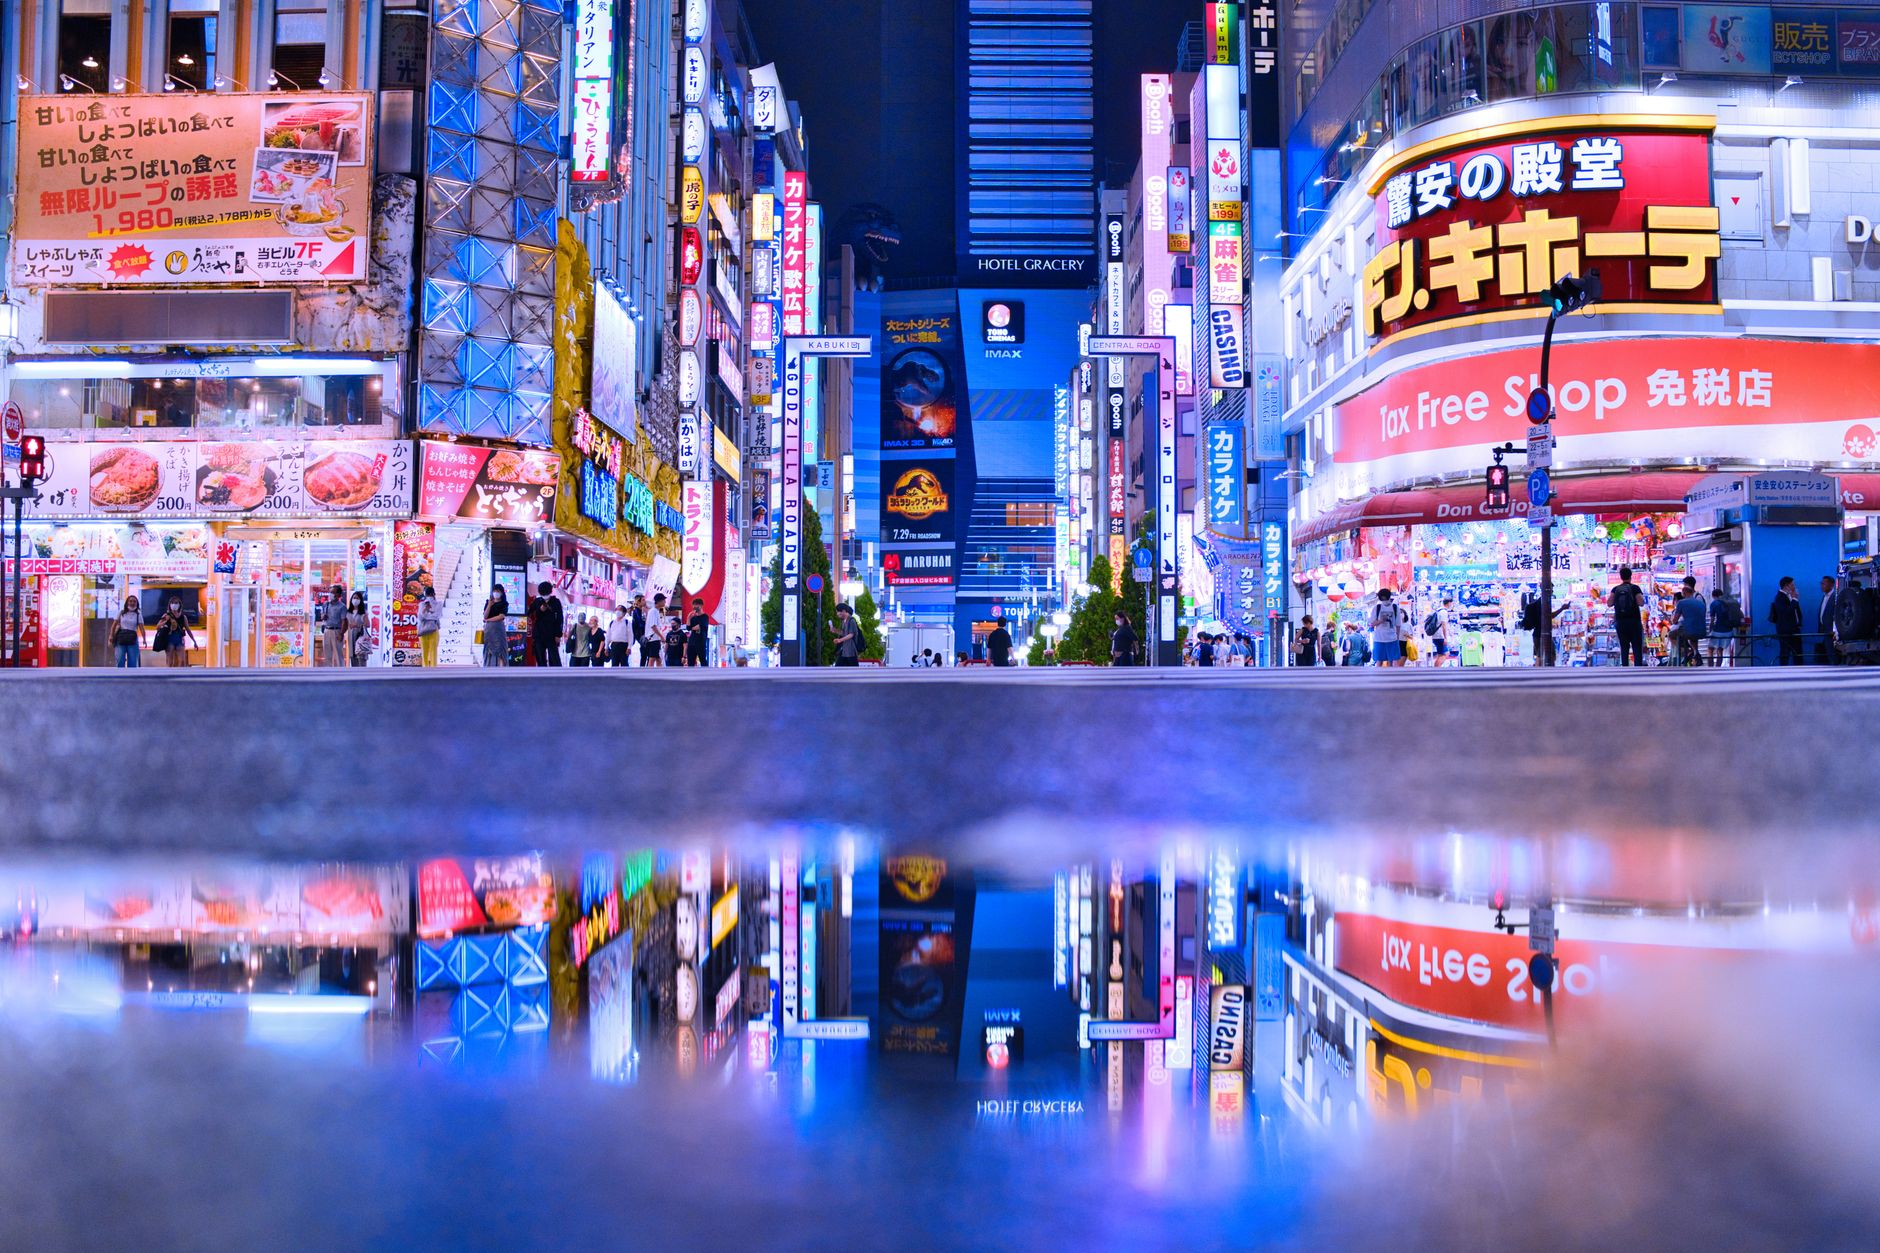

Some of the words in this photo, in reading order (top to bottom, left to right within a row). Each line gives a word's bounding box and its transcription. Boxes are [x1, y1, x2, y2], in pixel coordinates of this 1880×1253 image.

[1774, 22, 1829, 51] 販売
[35, 102, 132, 126] 甘いの食べて
[758, 90, 770, 122] ダーツ
[1145, 82, 1166, 135] Booth
[581, 97, 600, 169] ひょうたん
[37, 143, 134, 168] 甘いの食べて
[582, 171, 598, 180] 7F
[1385, 136, 1626, 230] 驚安の殿堂
[40, 172, 239, 217] 無限ループの誘惑
[685, 183, 701, 211] 虎の子
[1146, 176, 1167, 231] Booth
[1109, 221, 1123, 257] Booth
[1215, 223, 1236, 235] 4F
[26, 247, 103, 261] しゃぶしゃぶ
[113, 255, 147, 269] 食べ放題
[257, 242, 323, 261] 当ビル7F
[783, 178, 804, 335] カラオケ歌広場
[1214, 239, 1238, 283] 麻雀
[25, 264, 74, 277] スイーツ
[978, 259, 1024, 270] HOTEL
[1024, 259, 1085, 271] GRACERY
[886, 318, 950, 331] 大ヒットシリーズ
[985, 350, 1022, 358] IMAX
[1212, 309, 1242, 383] CASINO
[1645, 368, 1773, 408] 免税店
[1056, 388, 1067, 420] 747
[1109, 393, 1123, 430] Booth
[1380, 403, 1411, 442] Tax
[1417, 387, 1489, 430] Free
[1503, 373, 1627, 420] Shop
[786, 373, 798, 485] GODZILLA
[911, 439, 925, 447] 3D
[392, 443, 408, 491] かつ丼
[428, 451, 477, 465] お好み焼き
[427, 466, 476, 480] もんじゃ焼き
[1214, 430, 1235, 518] カラオケ
[1754, 480, 1830, 490] 安全安心ステーション
[426, 480, 466, 493] 焼きそば
[542, 487, 553, 495] 2F
[156, 496, 192, 511] 500円
[263, 495, 299, 509] 500円
[373, 495, 409, 509] 550円
[1437, 503, 1473, 518] Don
[685, 487, 701, 552] トラノコ
[786, 499, 798, 553] ROAD
[893, 529, 909, 540] 7.29
[217, 542, 234, 565] 氷
[904, 555, 952, 568] MARUHAN
[1265, 525, 1281, 594] カラオケ
[1240, 567, 1255, 625] カラオケ
[1266, 598, 1281, 608] B1
[393, 614, 418, 626] 2,50
